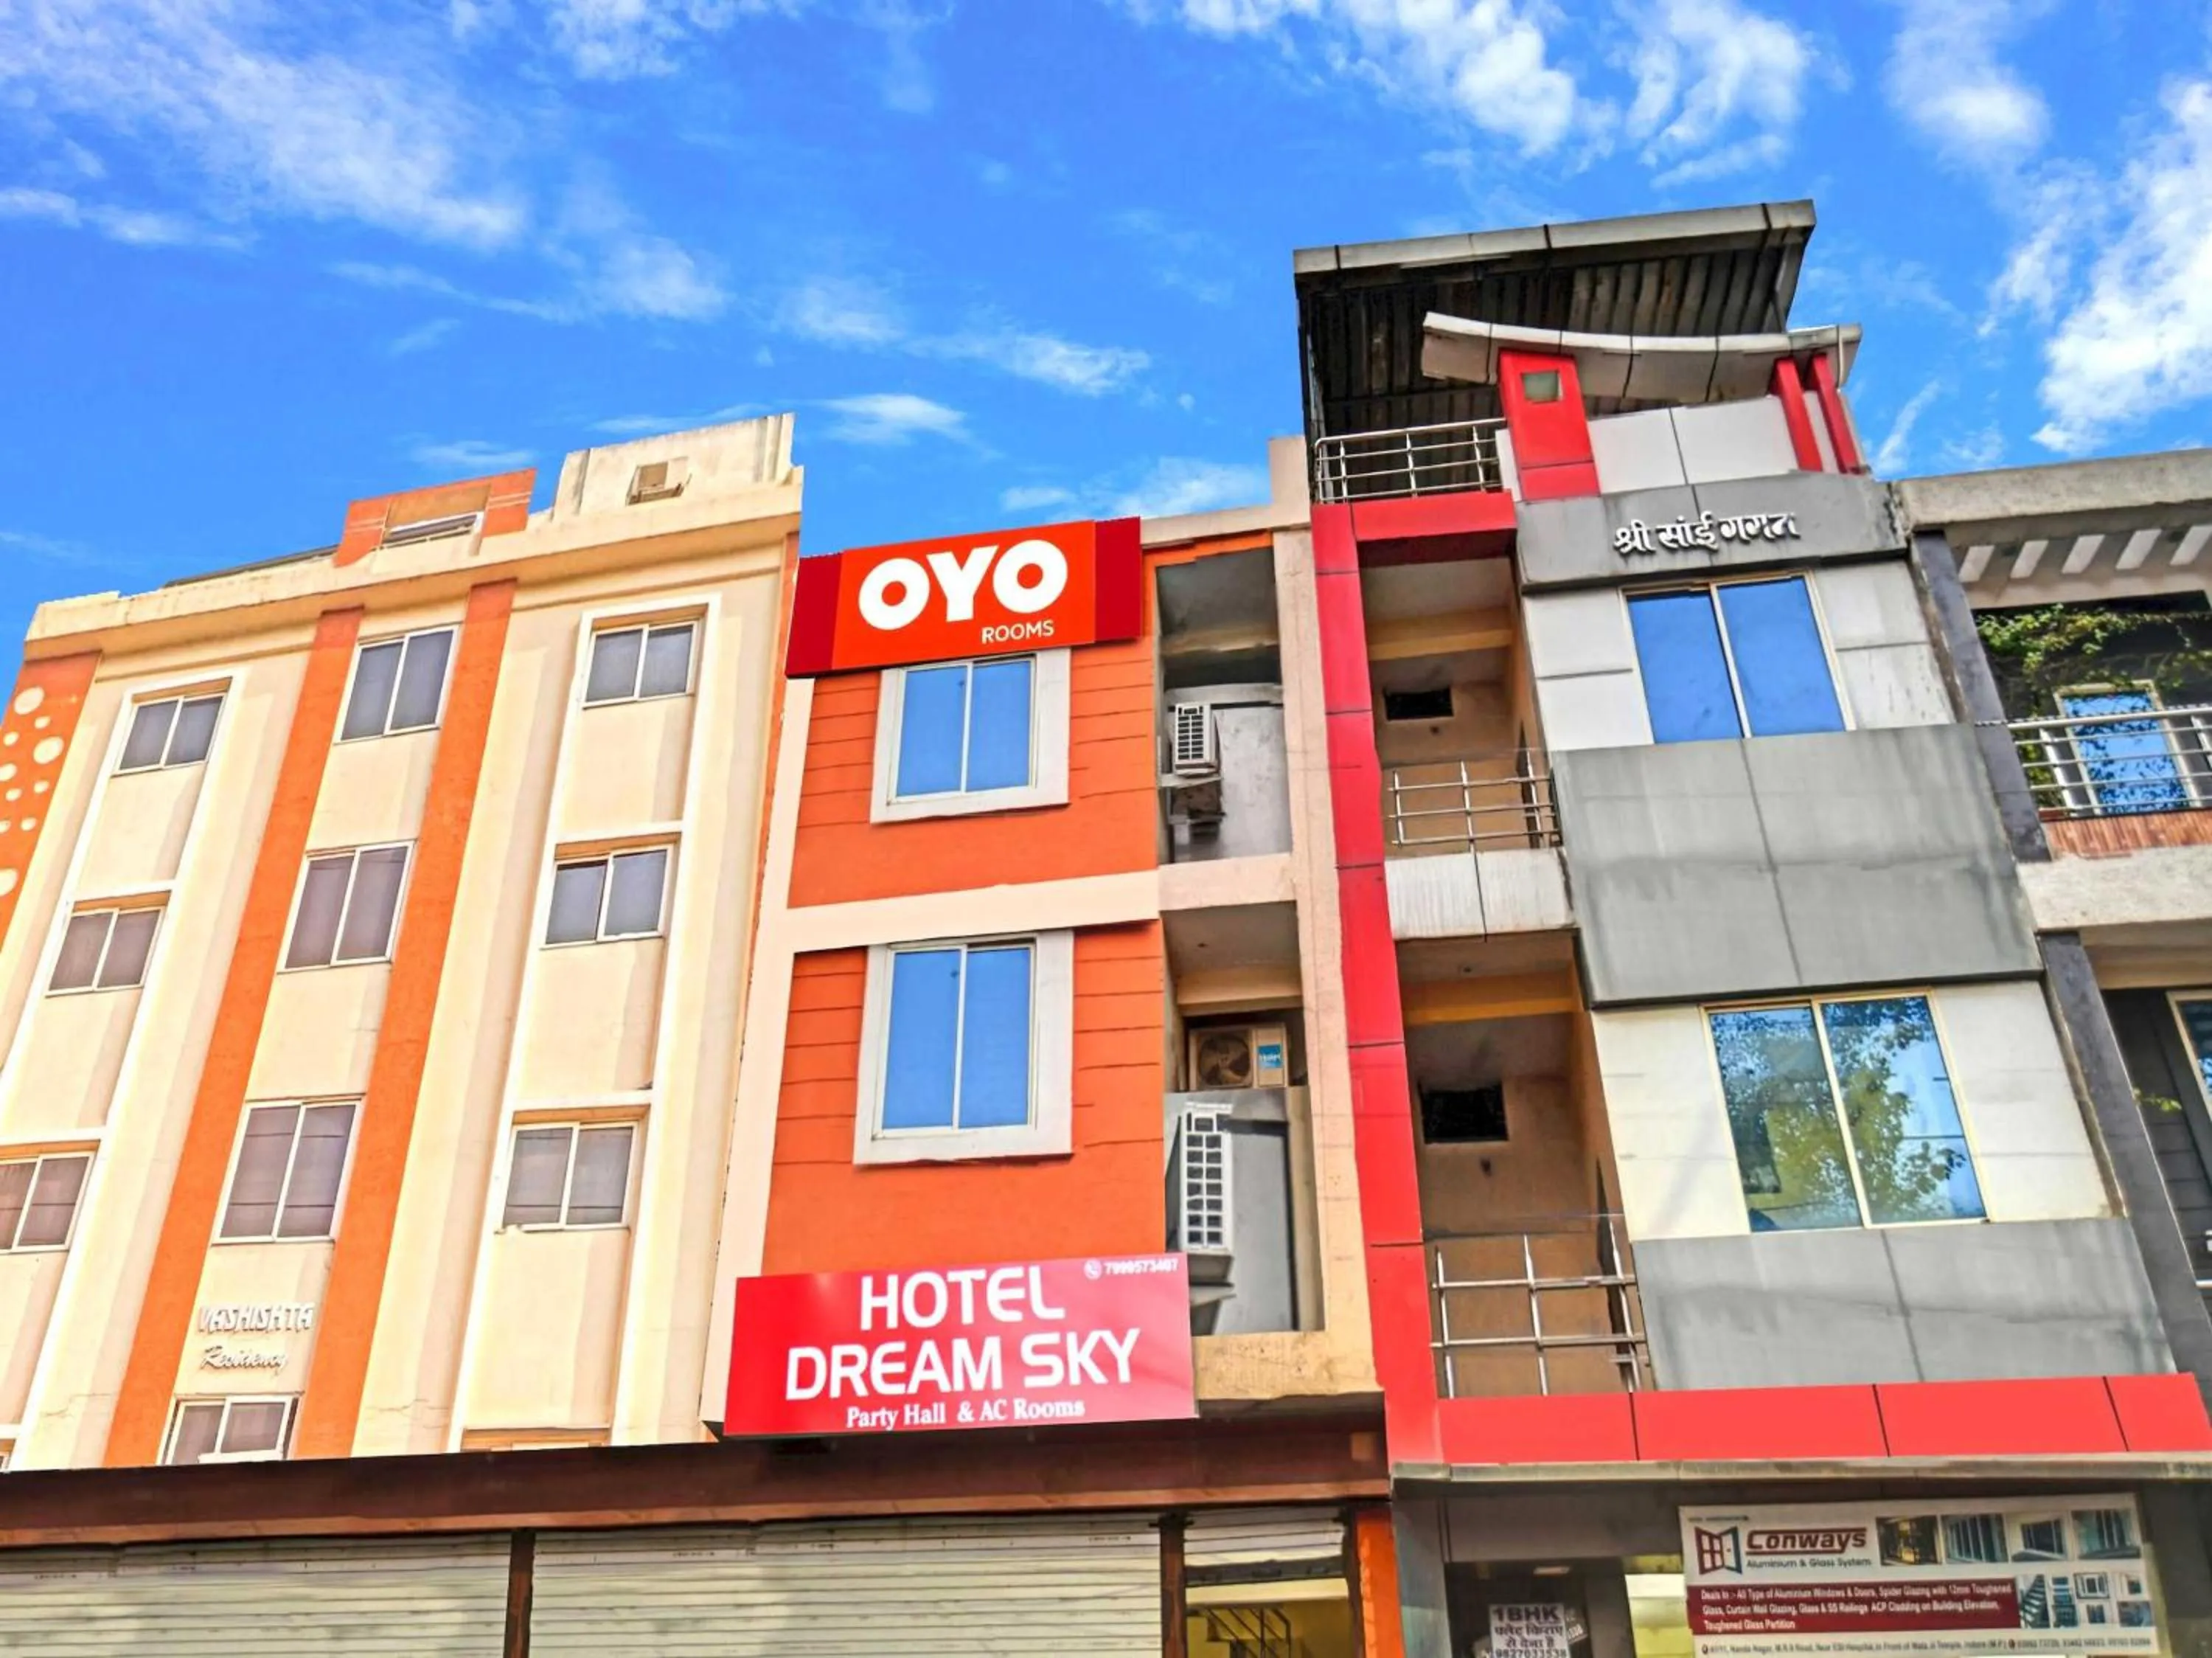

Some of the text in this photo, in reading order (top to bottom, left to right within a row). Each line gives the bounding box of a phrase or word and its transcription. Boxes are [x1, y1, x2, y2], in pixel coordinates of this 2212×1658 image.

[1614, 518, 1656, 553] श्री
[1719, 512, 1801, 541] गगन
[858, 539, 1068, 631] OYO
[981, 620, 1054, 644] ROOMS
[860, 1264, 1065, 1331] HOTEL
[785, 1328, 1141, 1401] DREAM SKY
[846, 1396, 1085, 1431] Party Hall & AC Rooms
[1746, 1528, 1867, 1555] Conways
[1746, 1556, 1872, 1569] Aluminium & Glass System
[1492, 1606, 1560, 1622] 1BHK
